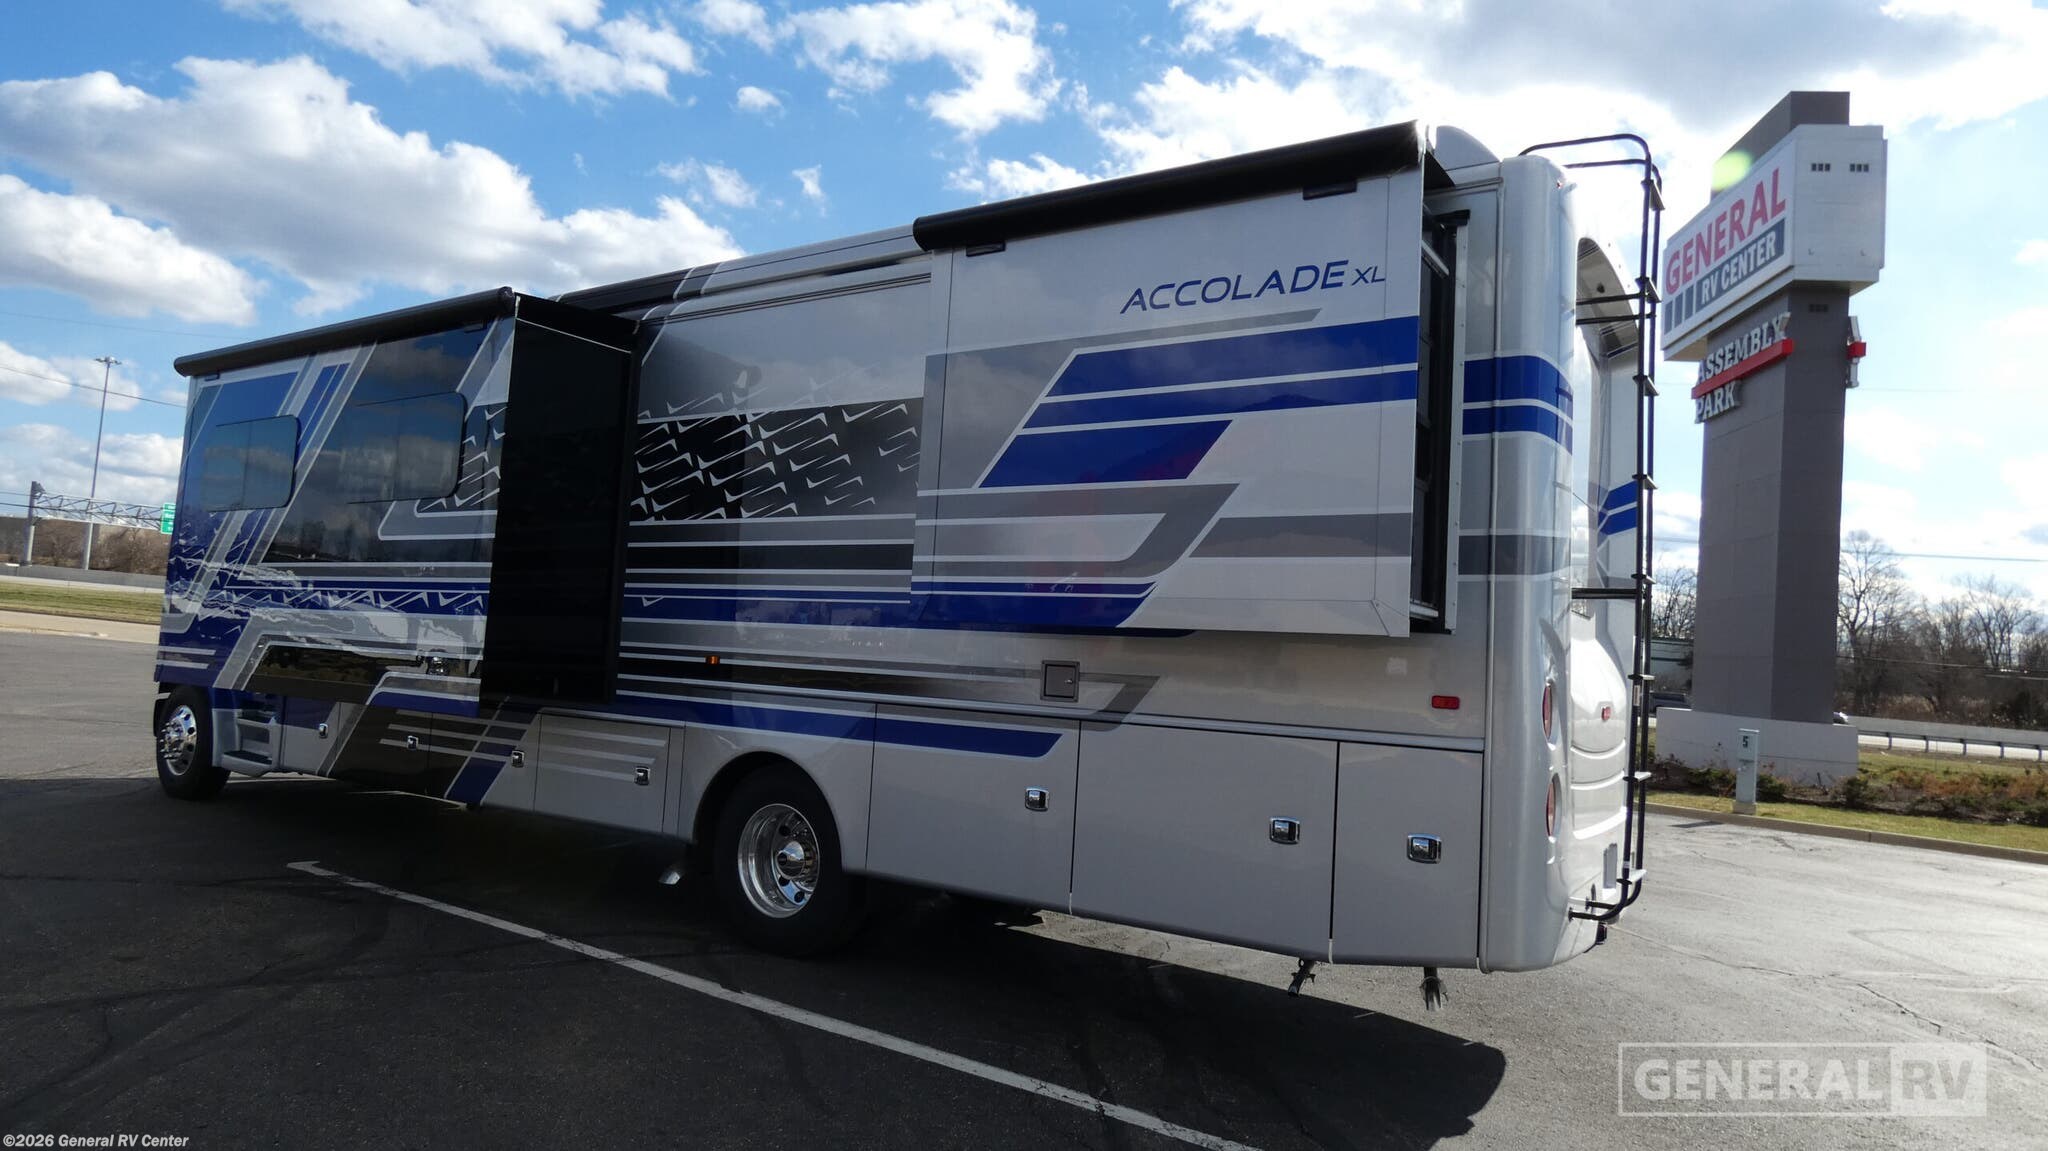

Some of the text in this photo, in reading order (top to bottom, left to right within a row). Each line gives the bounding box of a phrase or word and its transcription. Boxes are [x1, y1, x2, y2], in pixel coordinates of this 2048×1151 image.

[1666, 168, 1786, 295] GENERAL
[1702, 231, 1776, 304] RV CENTER
[1119, 260, 1386, 314] ACCOLADE XL
[1697, 312, 1790, 386] ASSEMBLY
[1695, 380, 1737, 424] PARK
